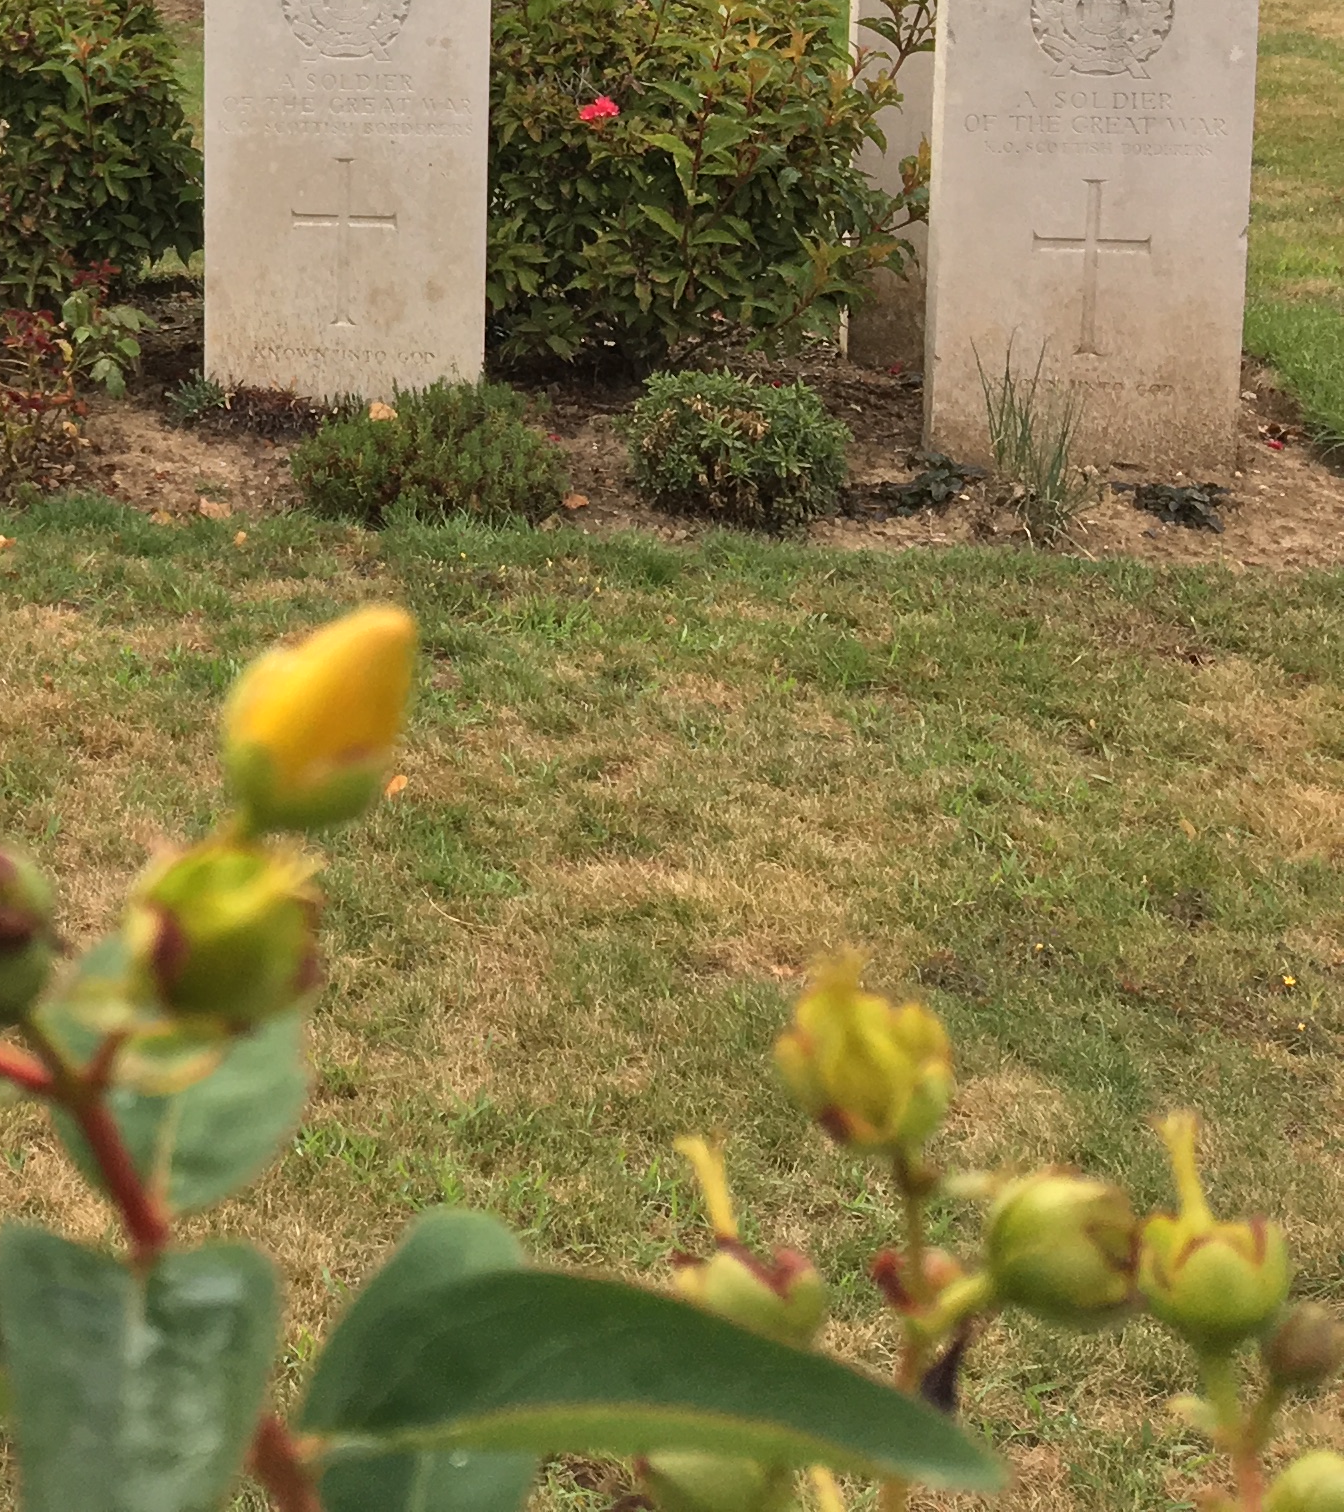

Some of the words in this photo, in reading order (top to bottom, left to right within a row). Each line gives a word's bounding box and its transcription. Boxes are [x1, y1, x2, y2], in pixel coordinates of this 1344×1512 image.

[278, 74, 297, 92] A
[305, 73, 416, 93] SOLDIER
[221, 96, 254, 115] OF
[264, 96, 315, 116] THE
[328, 96, 411, 116] GREAT
[420, 98, 474, 117] WAR
[1016, 90, 1038, 109] A
[1053, 90, 1174, 111] SOLDIER
[264, 121, 354, 136] SCOTTISH
[364, 121, 474, 137] BORDERERS
[962, 113, 998, 134] OF
[1008, 114, 1062, 135] THE
[1071, 115, 1157, 136] GREAT
[1166, 117, 1229, 138] WAR
[1025, 141, 1112, 156] SCOTTISH
[1120, 142, 1215, 158] BORDERERS
